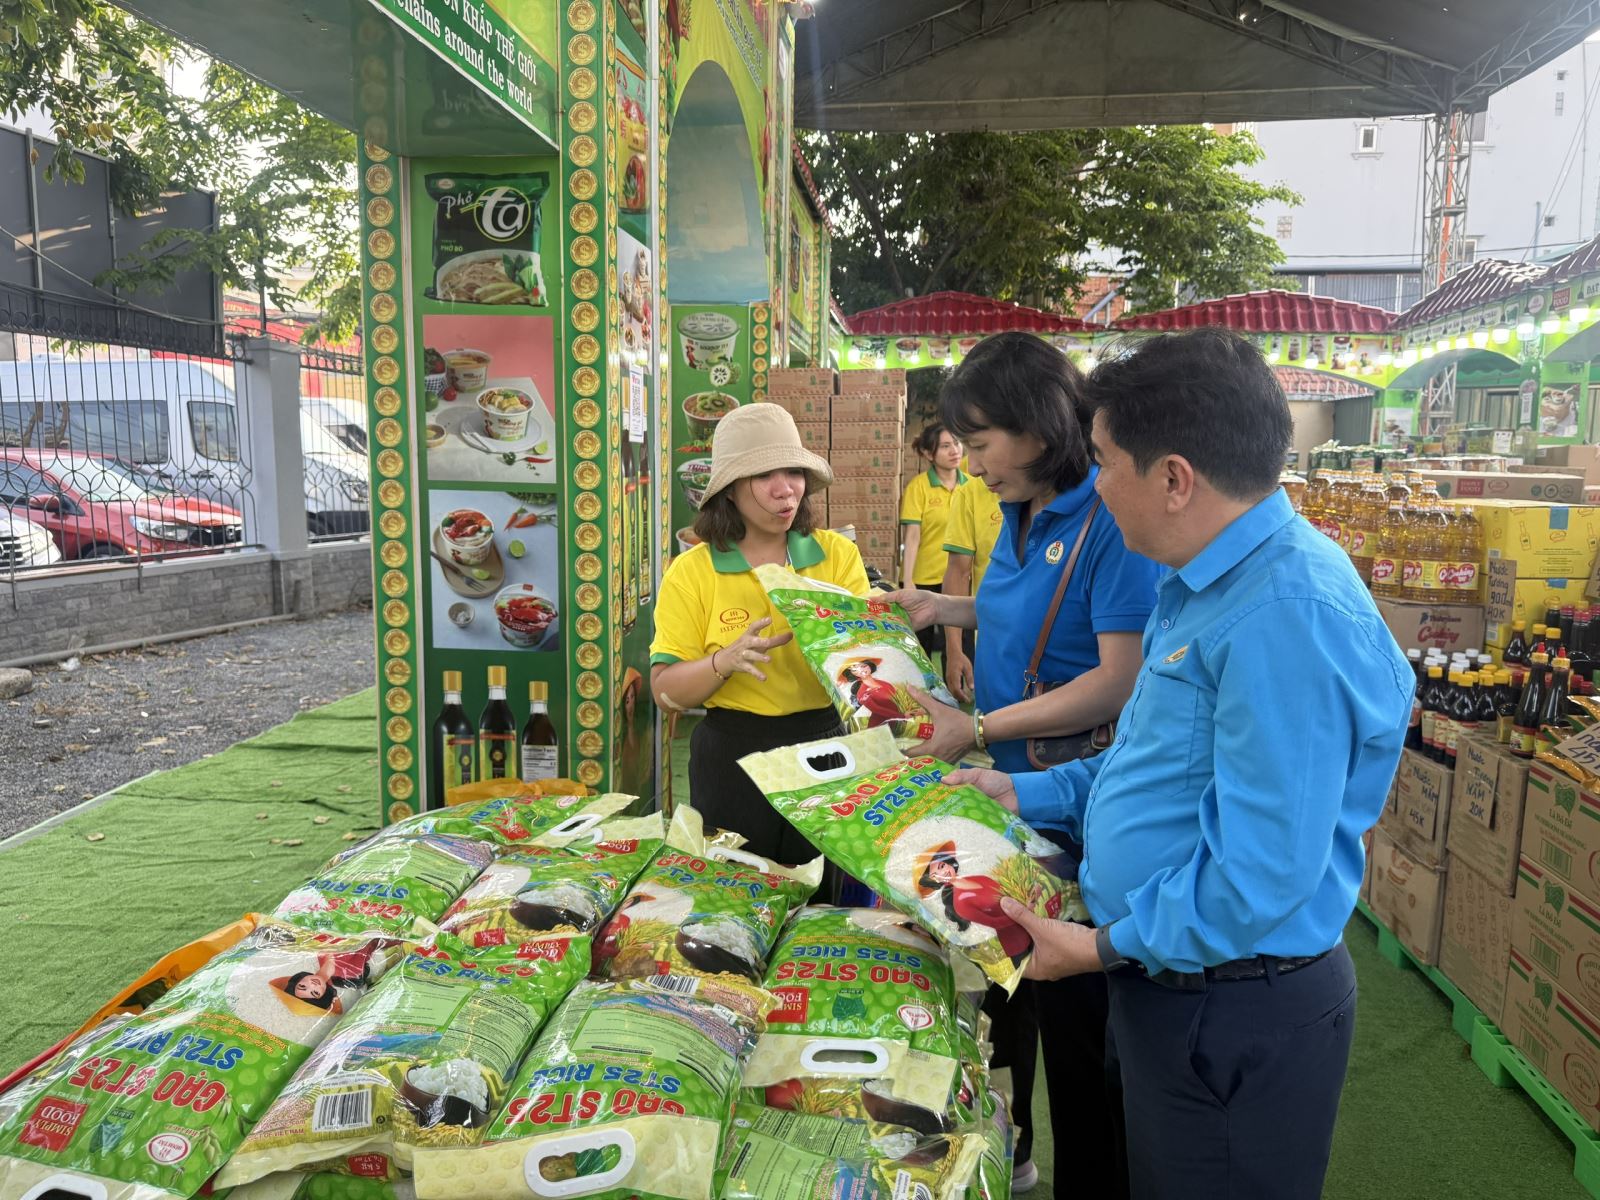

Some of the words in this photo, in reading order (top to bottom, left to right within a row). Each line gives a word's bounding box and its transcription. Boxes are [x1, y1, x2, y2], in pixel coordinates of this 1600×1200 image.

[444, 26, 485, 75] around
[487, 57, 504, 91] the
[507, 79, 533, 114] world
[495, 30, 515, 66] THẾ
[518, 50, 537, 85] GIỚI
[831, 783, 880, 817] GẠO
[863, 785, 917, 827] ST25
[791, 945, 847, 959] RICE
[856, 947, 922, 968] ST25
[776, 961, 859, 982] ST25
[869, 965, 932, 991] GẠO
[173, 1035, 244, 1070] ST25
[69, 1056, 157, 1097] ST25
[152, 1070, 227, 1113] GẠO
[528, 1063, 595, 1089] RICE
[602, 1065, 681, 1094] ST25
[40, 1105, 80, 1124] FOOD
[504, 1090, 602, 1126] ST25
[34, 1118, 74, 1136] SIMPLY
